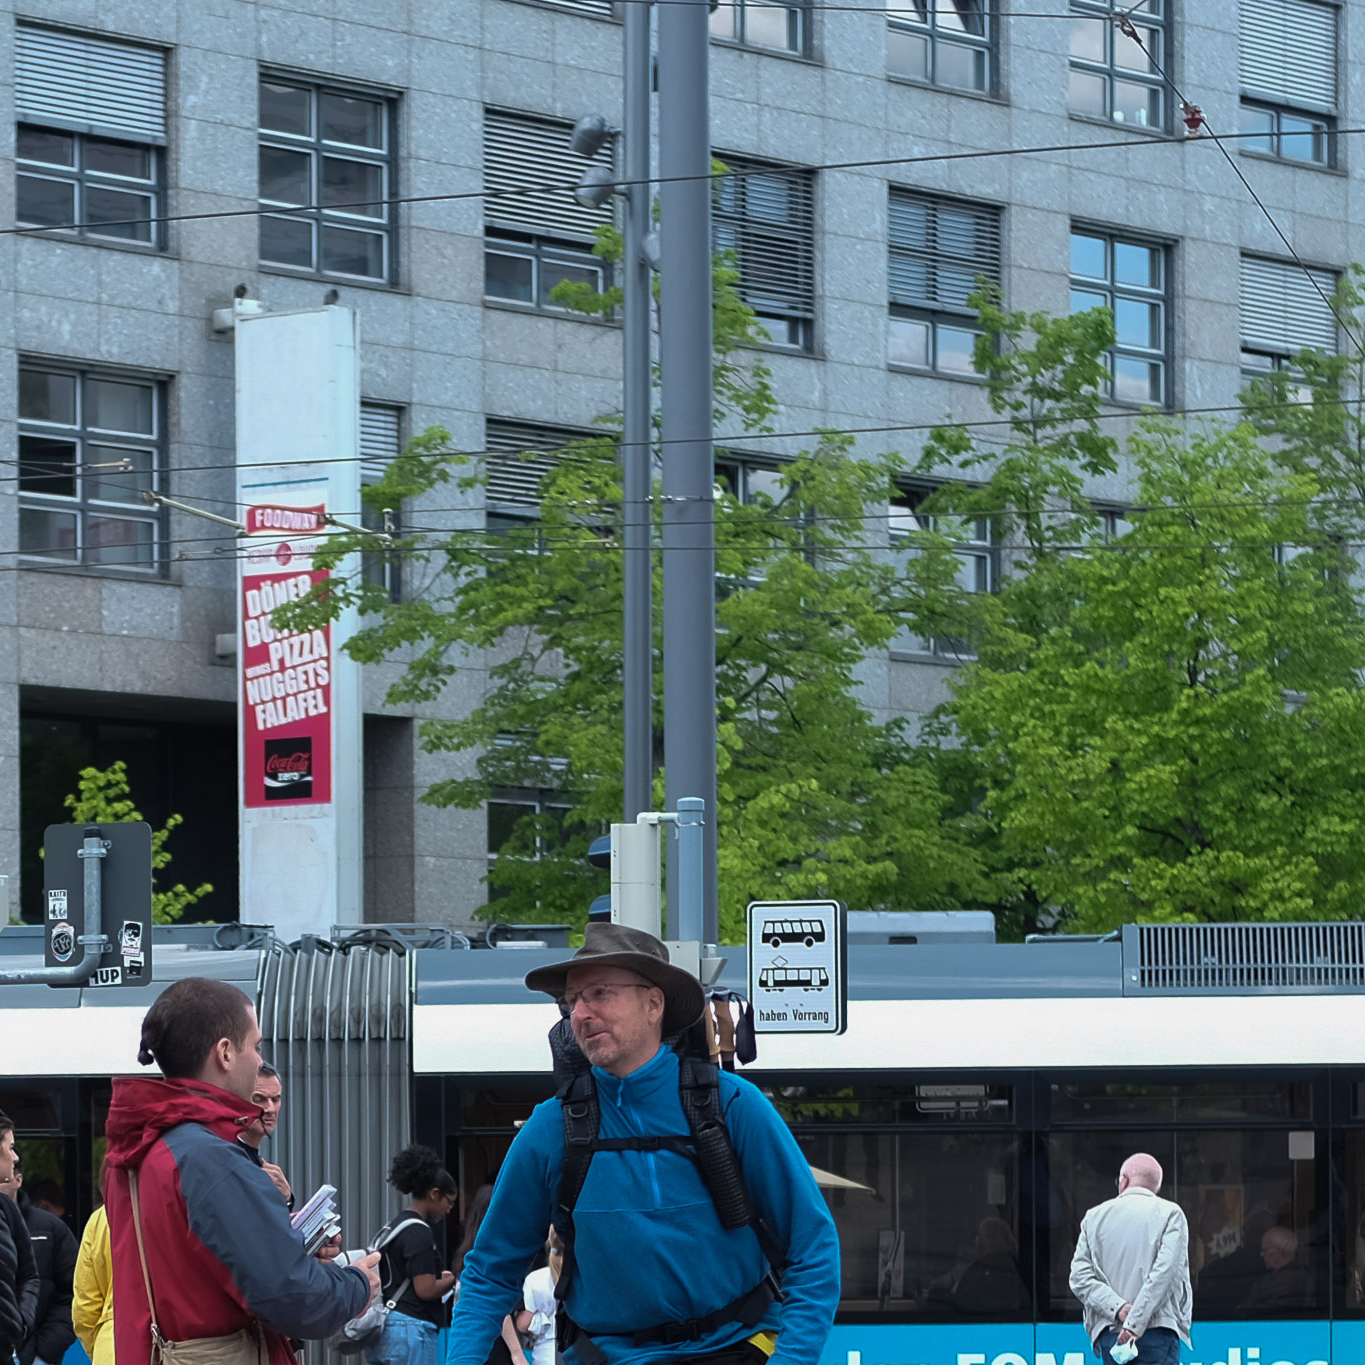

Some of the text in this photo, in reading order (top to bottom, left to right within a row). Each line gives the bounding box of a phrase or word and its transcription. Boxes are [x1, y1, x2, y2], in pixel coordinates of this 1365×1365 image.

[269, 630, 328, 671] PIZZA
[246, 660, 330, 705] NUGGETS
[256, 689, 328, 731] FALAFEL
[759, 1008, 829, 1024] haben Vorrang
